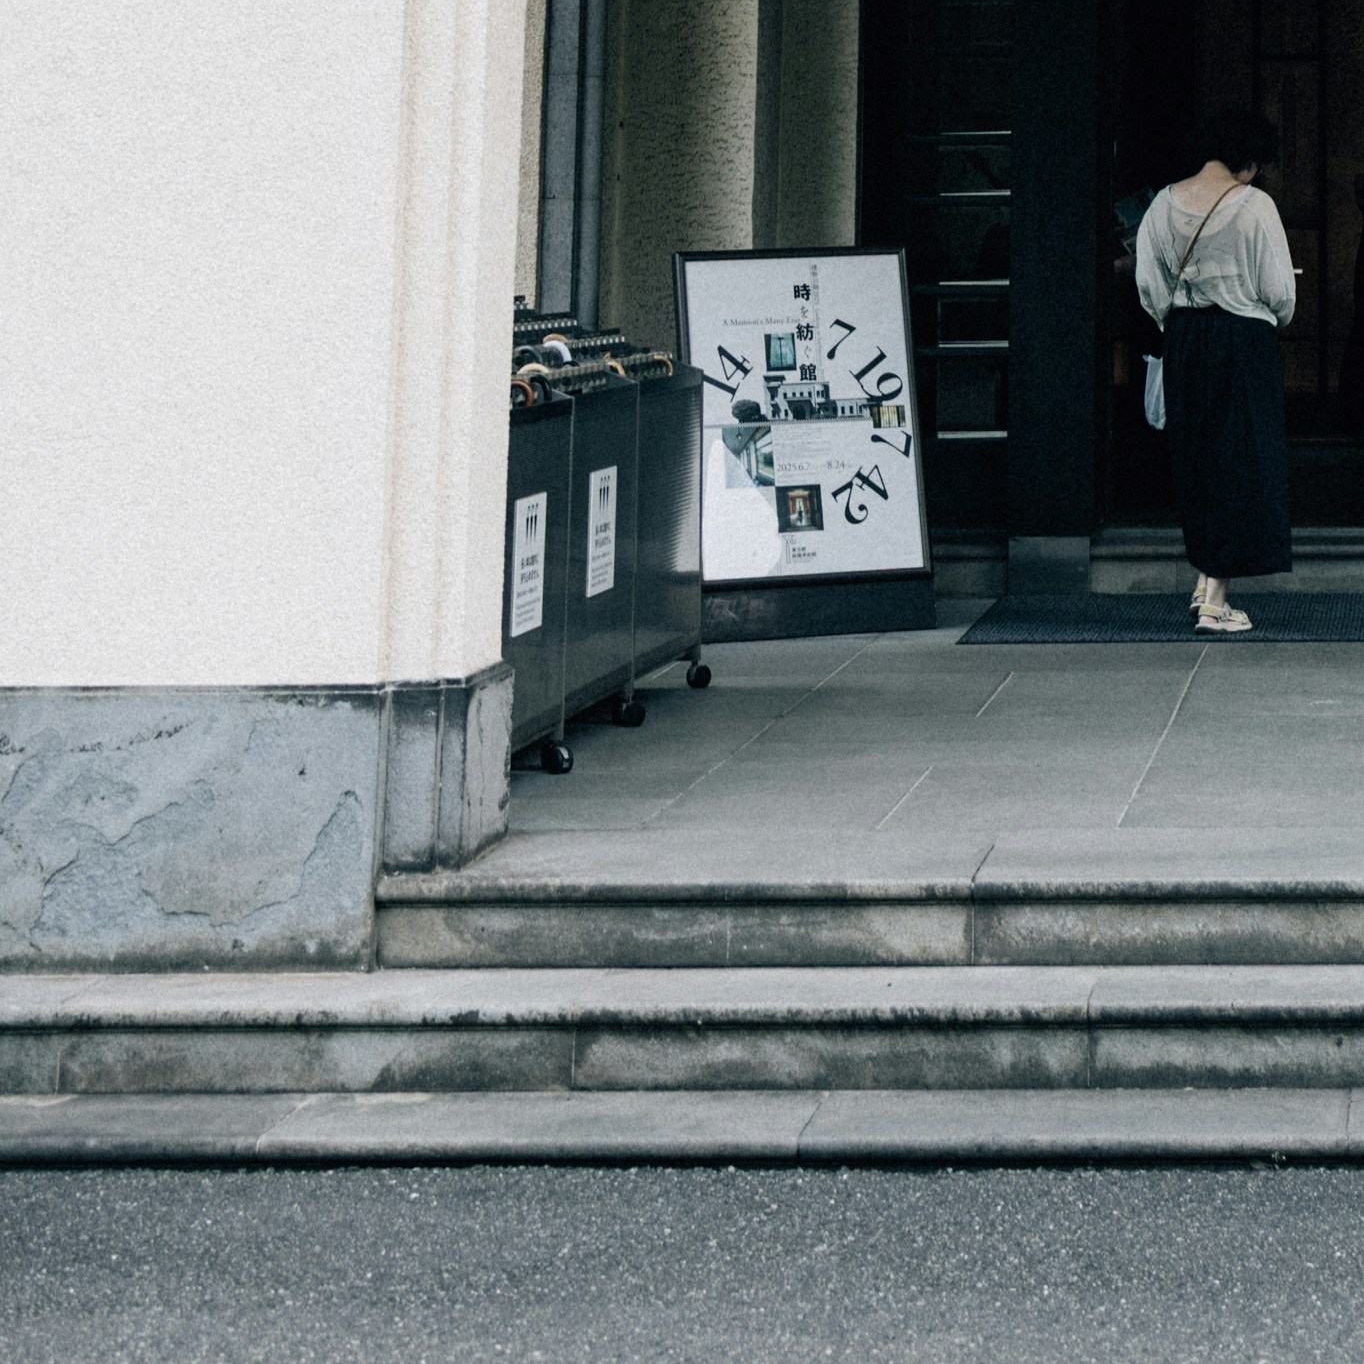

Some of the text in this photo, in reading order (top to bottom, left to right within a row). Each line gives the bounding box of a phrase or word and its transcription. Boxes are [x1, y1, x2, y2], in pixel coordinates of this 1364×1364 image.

[765, 317, 784, 326] Many
[793, 283, 817, 381] 時を紡ぐ館
